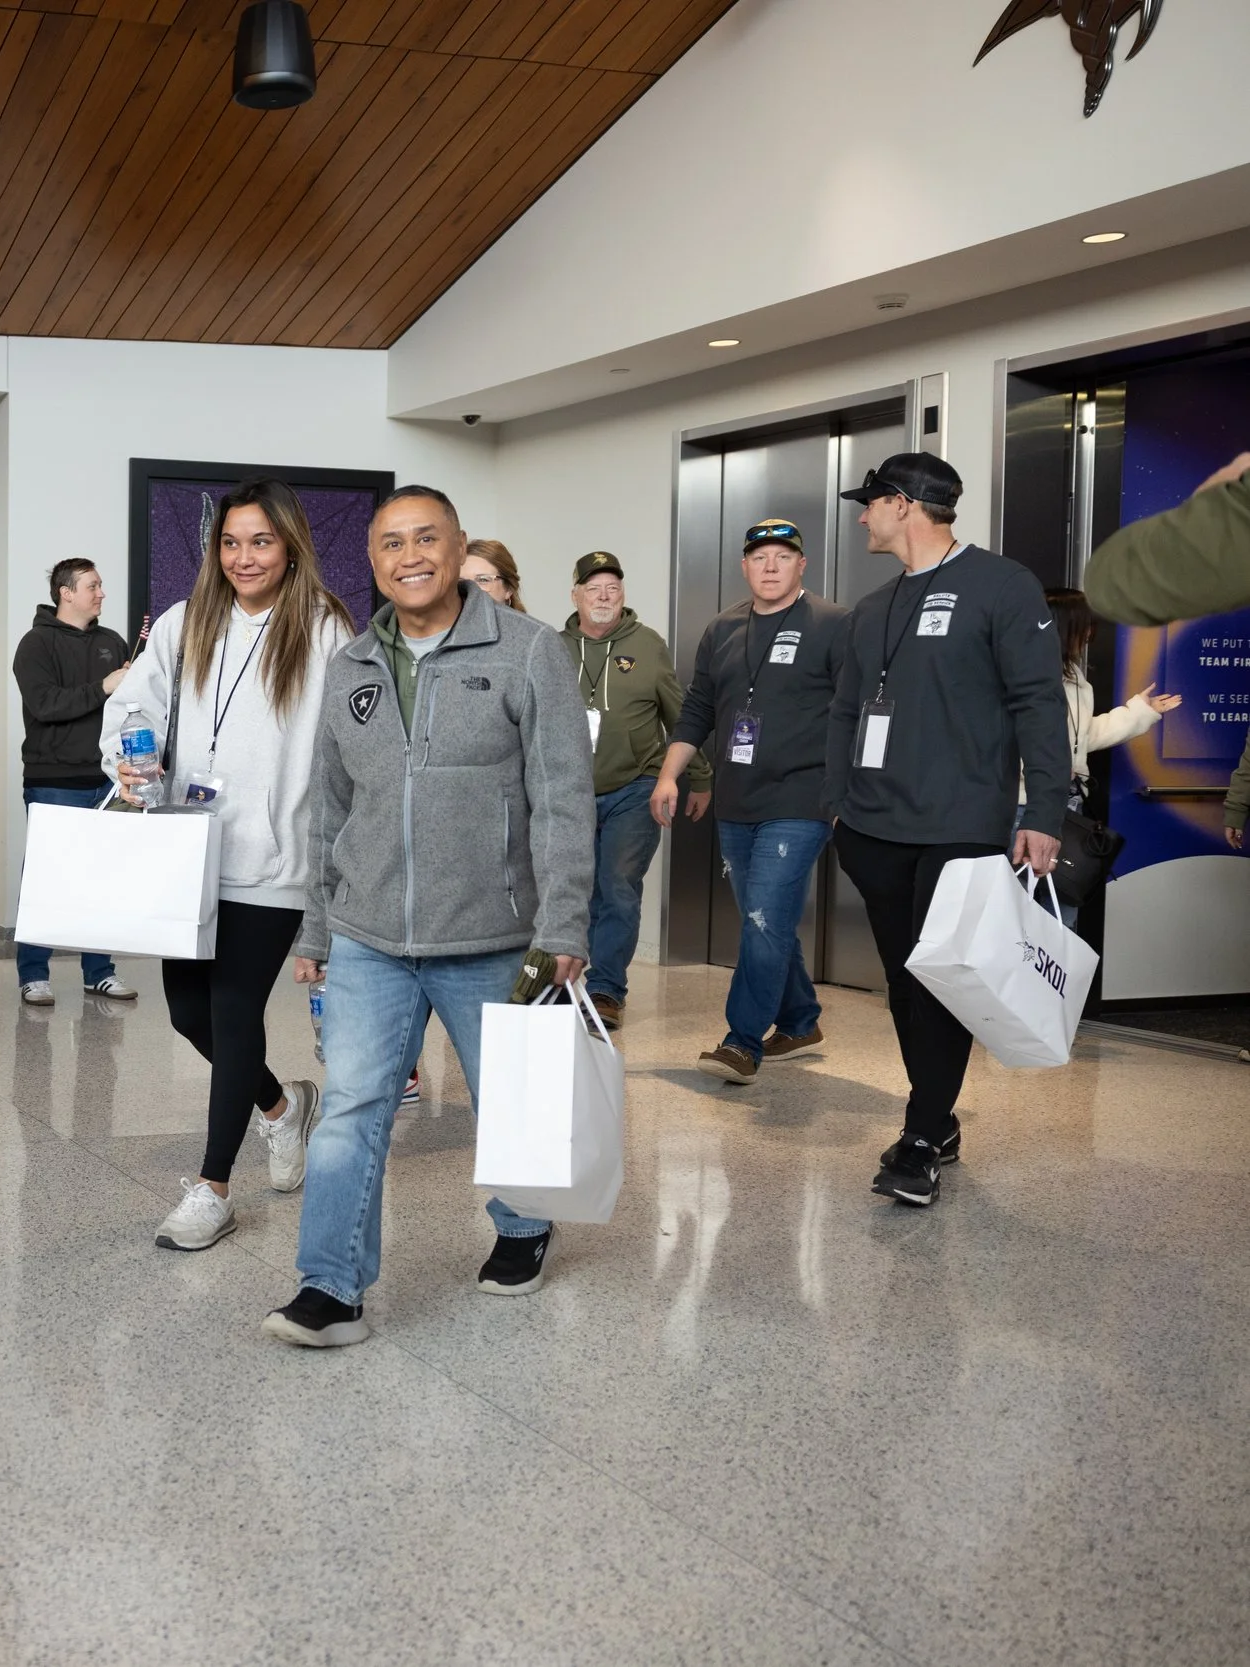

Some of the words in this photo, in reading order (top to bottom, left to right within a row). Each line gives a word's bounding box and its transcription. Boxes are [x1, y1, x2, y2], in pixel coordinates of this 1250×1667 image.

[1202, 638, 1218, 648] WE
[1222, 639, 1243, 649] PUT
[1199, 656, 1230, 667] TEAM
[1233, 658, 1250, 668] FIR
[1209, 694, 1225, 704] WE
[1202, 712, 1216, 722] TO
[1034, 946, 1068, 1000] SKOL
